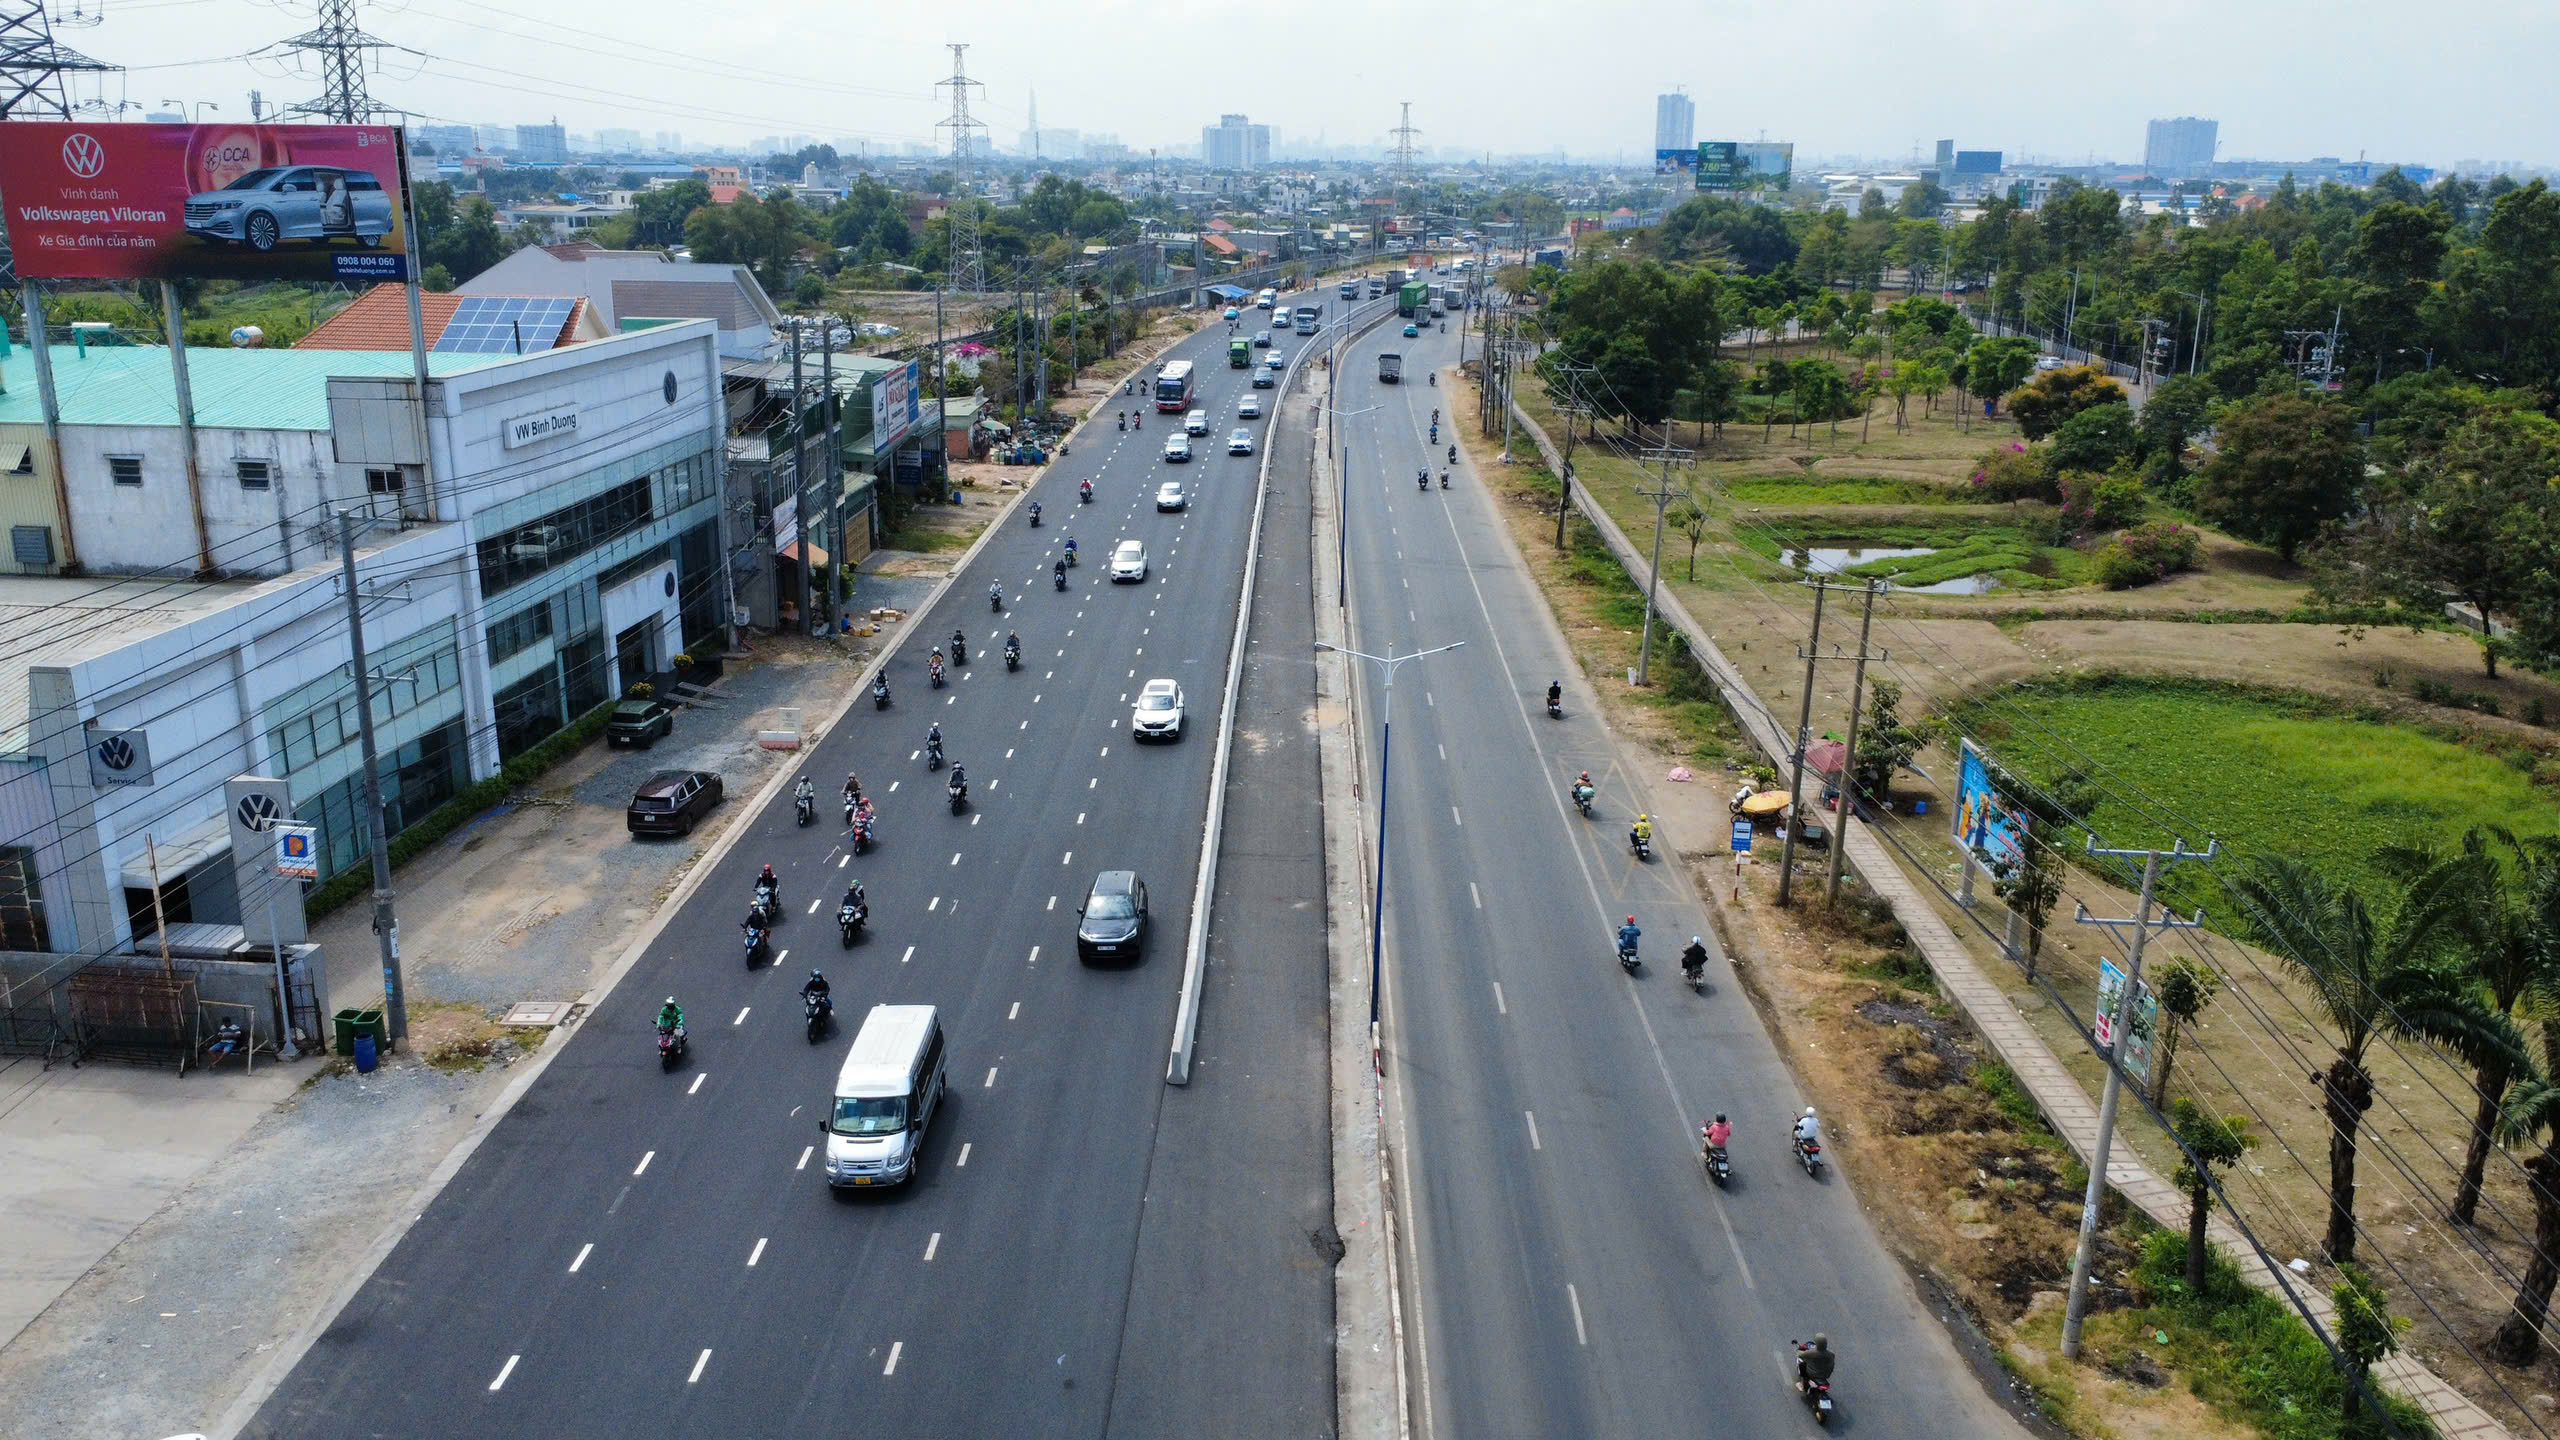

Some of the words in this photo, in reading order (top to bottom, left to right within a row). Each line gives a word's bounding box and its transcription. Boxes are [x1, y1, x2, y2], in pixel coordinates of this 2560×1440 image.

[223, 148, 250, 162] CCA
[60, 188, 87, 200] Vinh
[90, 188, 119, 200] danh
[20, 206, 110, 224] Volkswagen
[111, 207, 166, 222] Viloran
[38, 235, 53, 246] Xe
[56, 235, 75, 247] Gia
[107, 234, 127, 247] của
[130, 235, 156, 248] năm
[337, 256, 359, 265] 0908
[360, 257, 377, 266] 004
[378, 257, 395, 266] 060
[515, 422, 530, 440] VW
[531, 419, 550, 437] Binh
[551, 413, 577, 429] Duong
